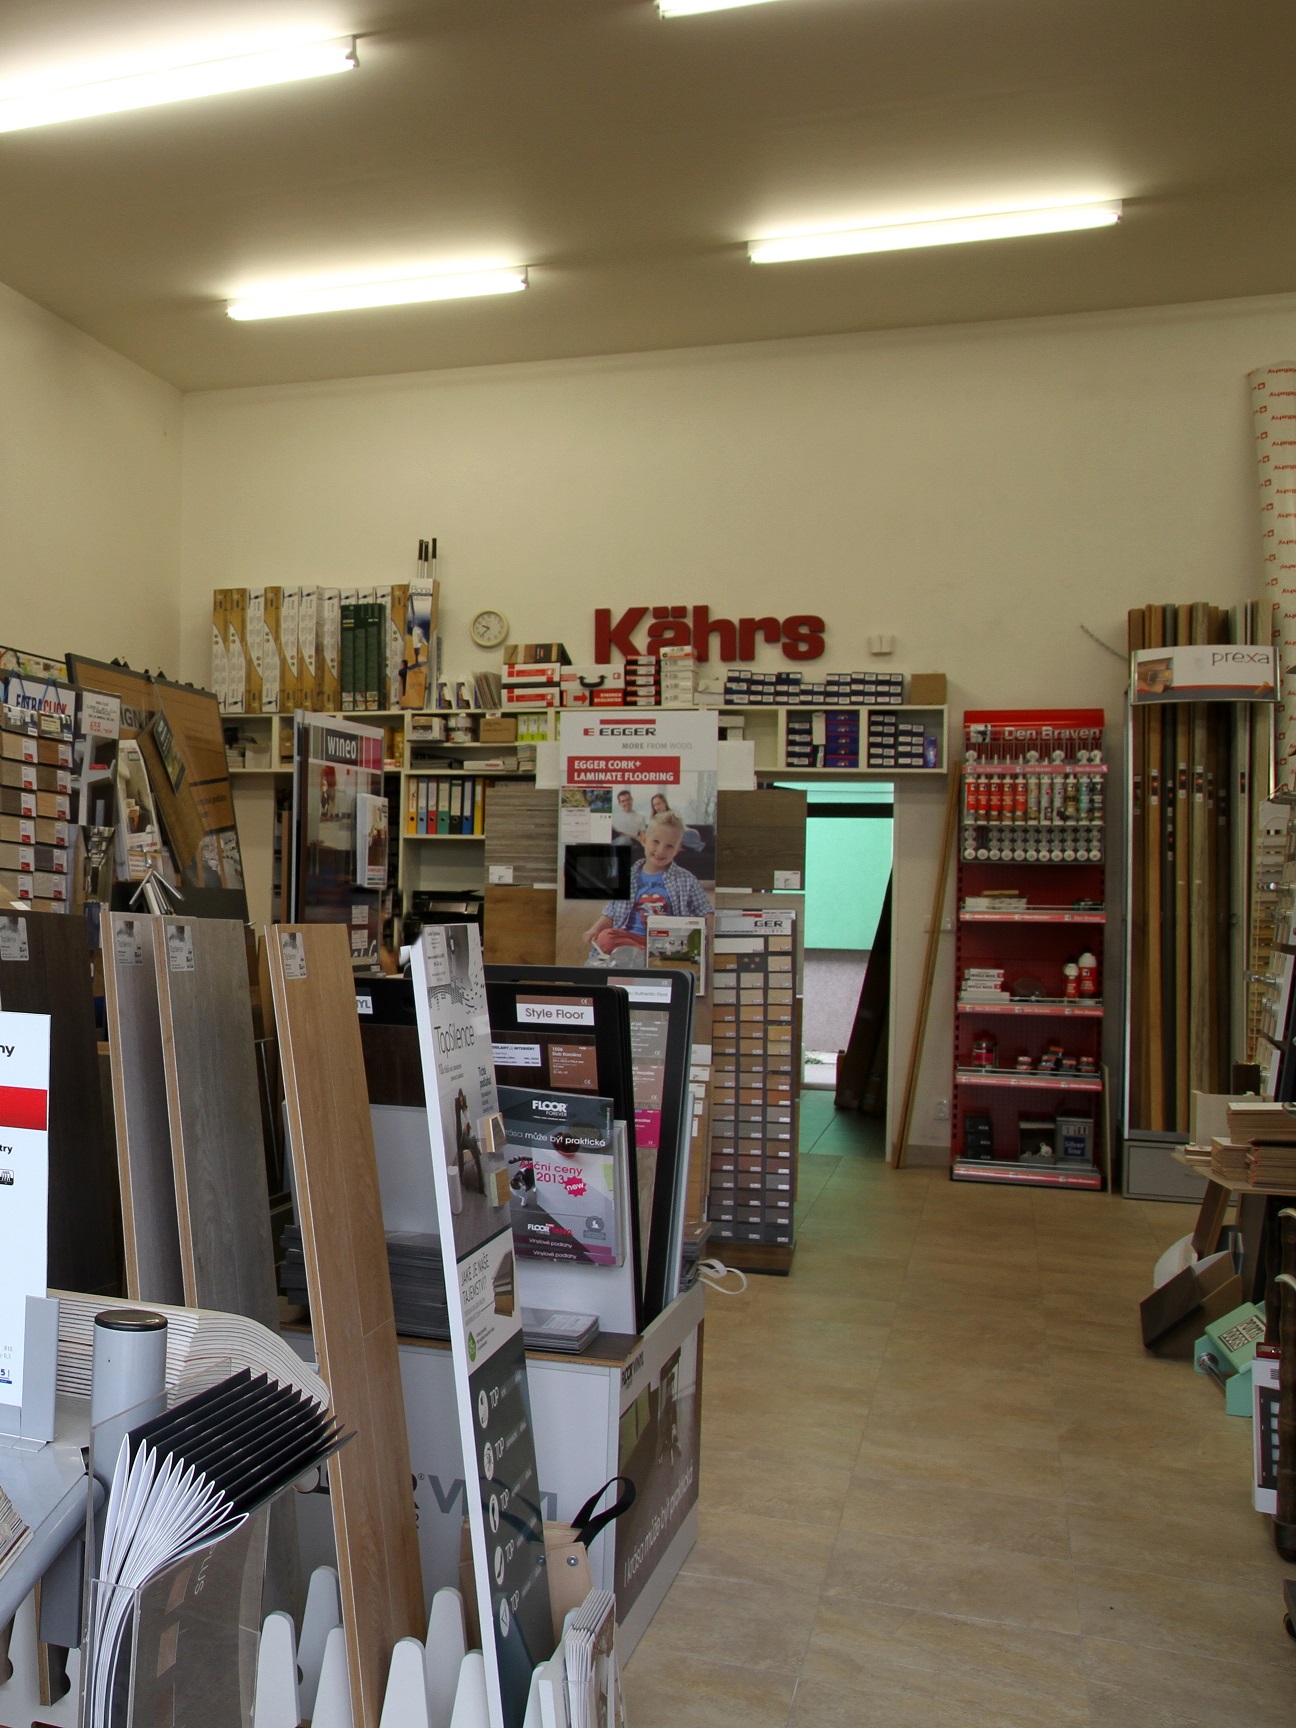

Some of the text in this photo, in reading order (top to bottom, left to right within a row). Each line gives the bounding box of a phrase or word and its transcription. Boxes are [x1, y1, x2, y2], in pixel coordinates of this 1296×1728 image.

[594, 605, 824, 664] Kährs
[1212, 652, 1270, 666] prexa
[599, 728, 656, 736] EGGER
[1004, 726, 1100, 740] Den Braven
[328, 736, 357, 760] wineo
[622, 742, 644, 750] MORE
[646, 742, 668, 750] FROM
[574, 760, 642, 769] EGGER CORK+
[574, 772, 674, 781] LAMINATE FLOORING
[754, 920, 783, 928] GER
[526, 1007, 584, 1021] Style Floor
[532, 1100, 568, 1112] FLOOR
[505, 1128, 606, 1147] rása může být praktická
[519, 1159, 582, 1177] Akční ceny
[536, 1172, 565, 1184] 2013
[566, 1182, 584, 1190] new
[528, 1224, 550, 1232] FLOOR
[528, 1238, 572, 1248] Vinylové podlahy
[555, 1252, 577, 1260] podlahy
[0, 1368, 6, 1376] 5
[489, 1386, 500, 1409] TOP
[494, 1437, 504, 1461] TOP
[500, 1488, 510, 1512] TOP
[505, 1541, 515, 1564] TOP
[510, 1590, 520, 1613] TOP
